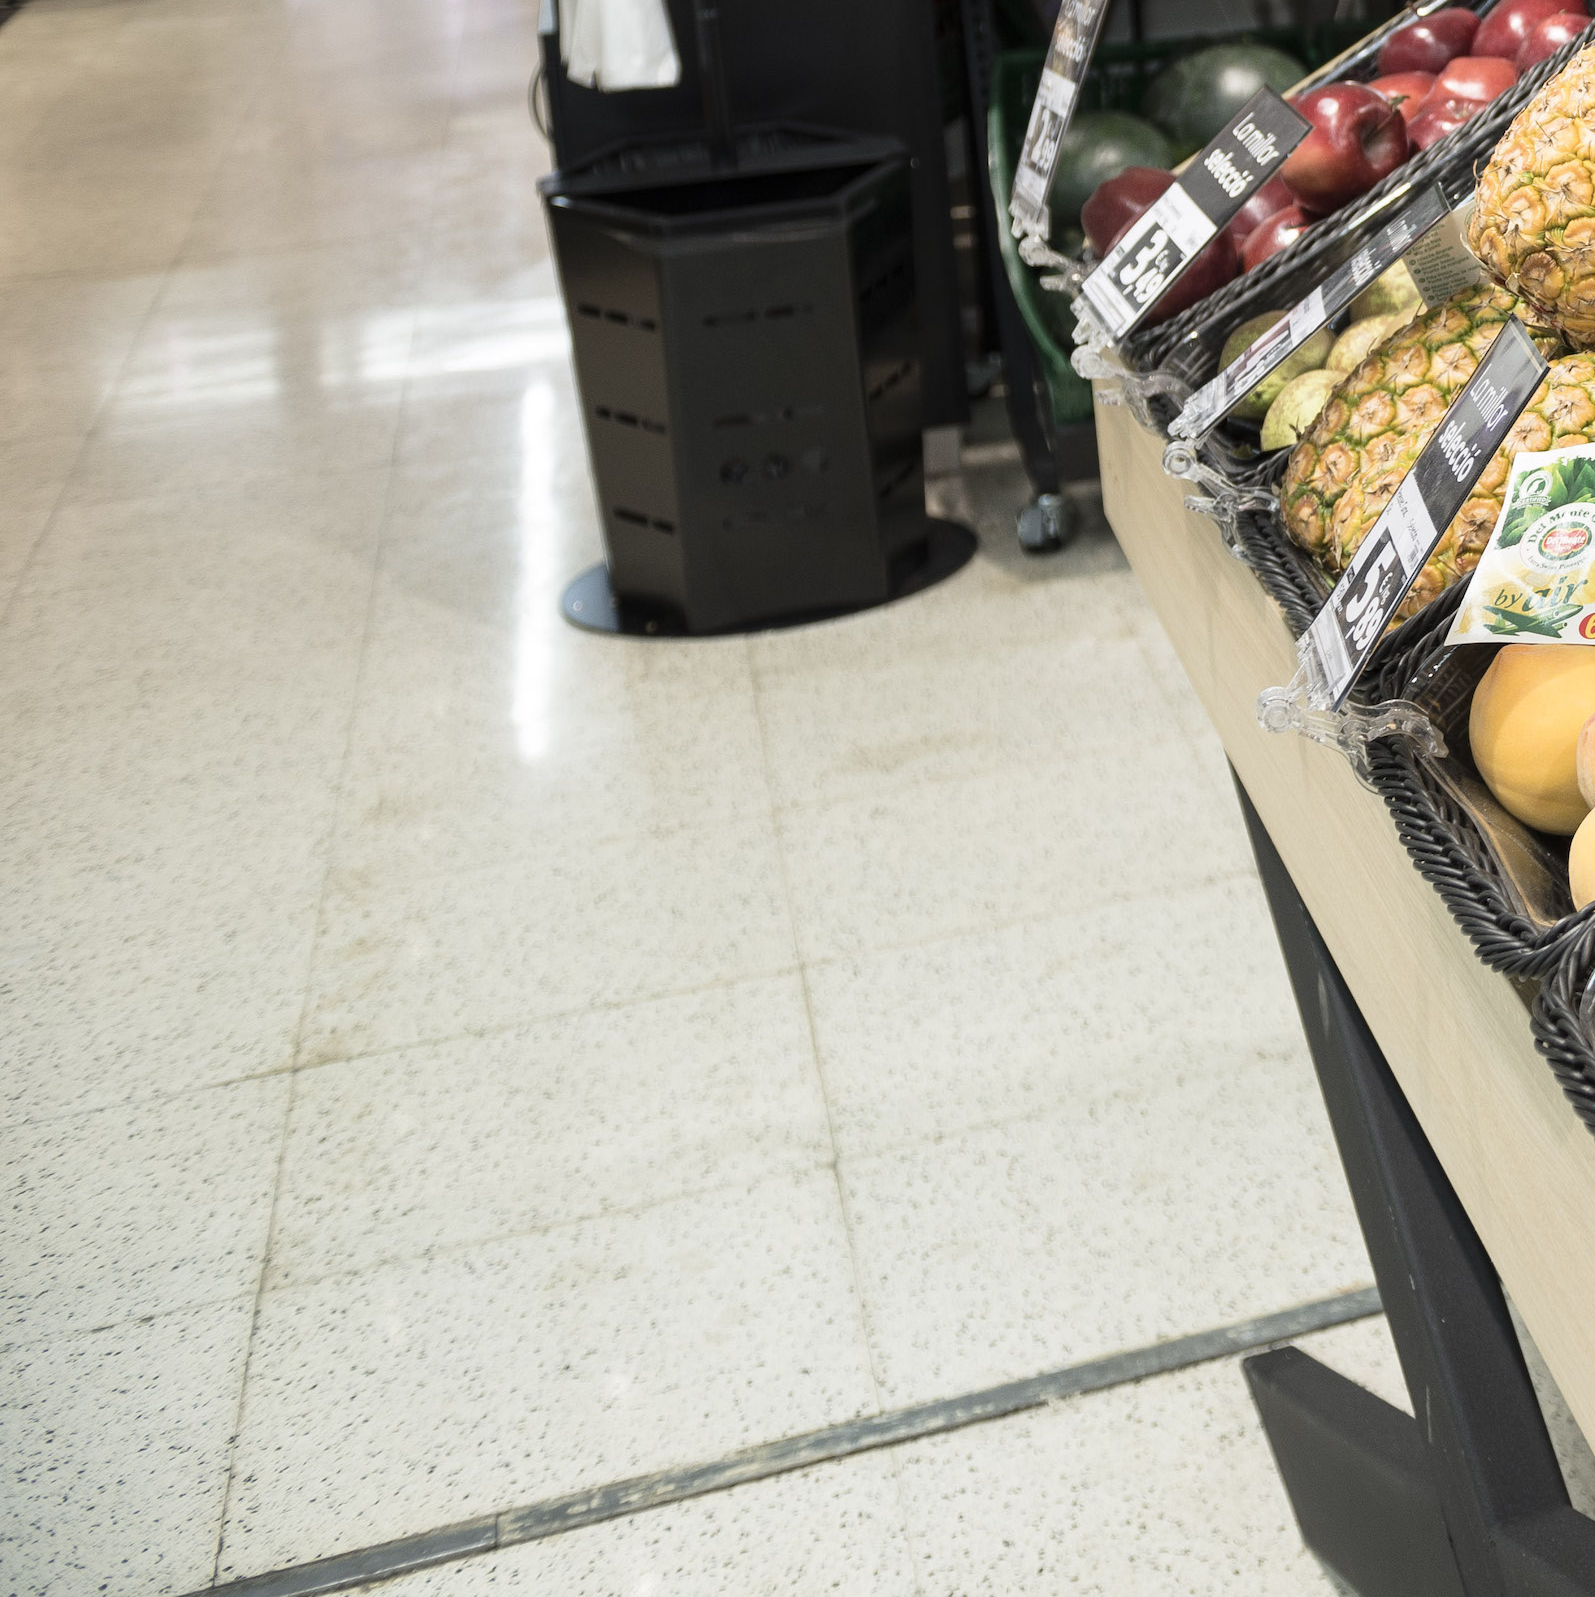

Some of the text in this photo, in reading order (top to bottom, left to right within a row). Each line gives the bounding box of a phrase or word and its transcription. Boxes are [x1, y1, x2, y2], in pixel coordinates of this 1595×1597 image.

[1232, 112, 1280, 166] La millor
[1204, 148, 1254, 199] selecció
[1119, 229, 1168, 304] 3,49
[1469, 363, 1509, 433] La millor
[1438, 419, 1482, 483] selecció
[1345, 540, 1399, 651] 5,89
[1494, 576, 1589, 612] by air
